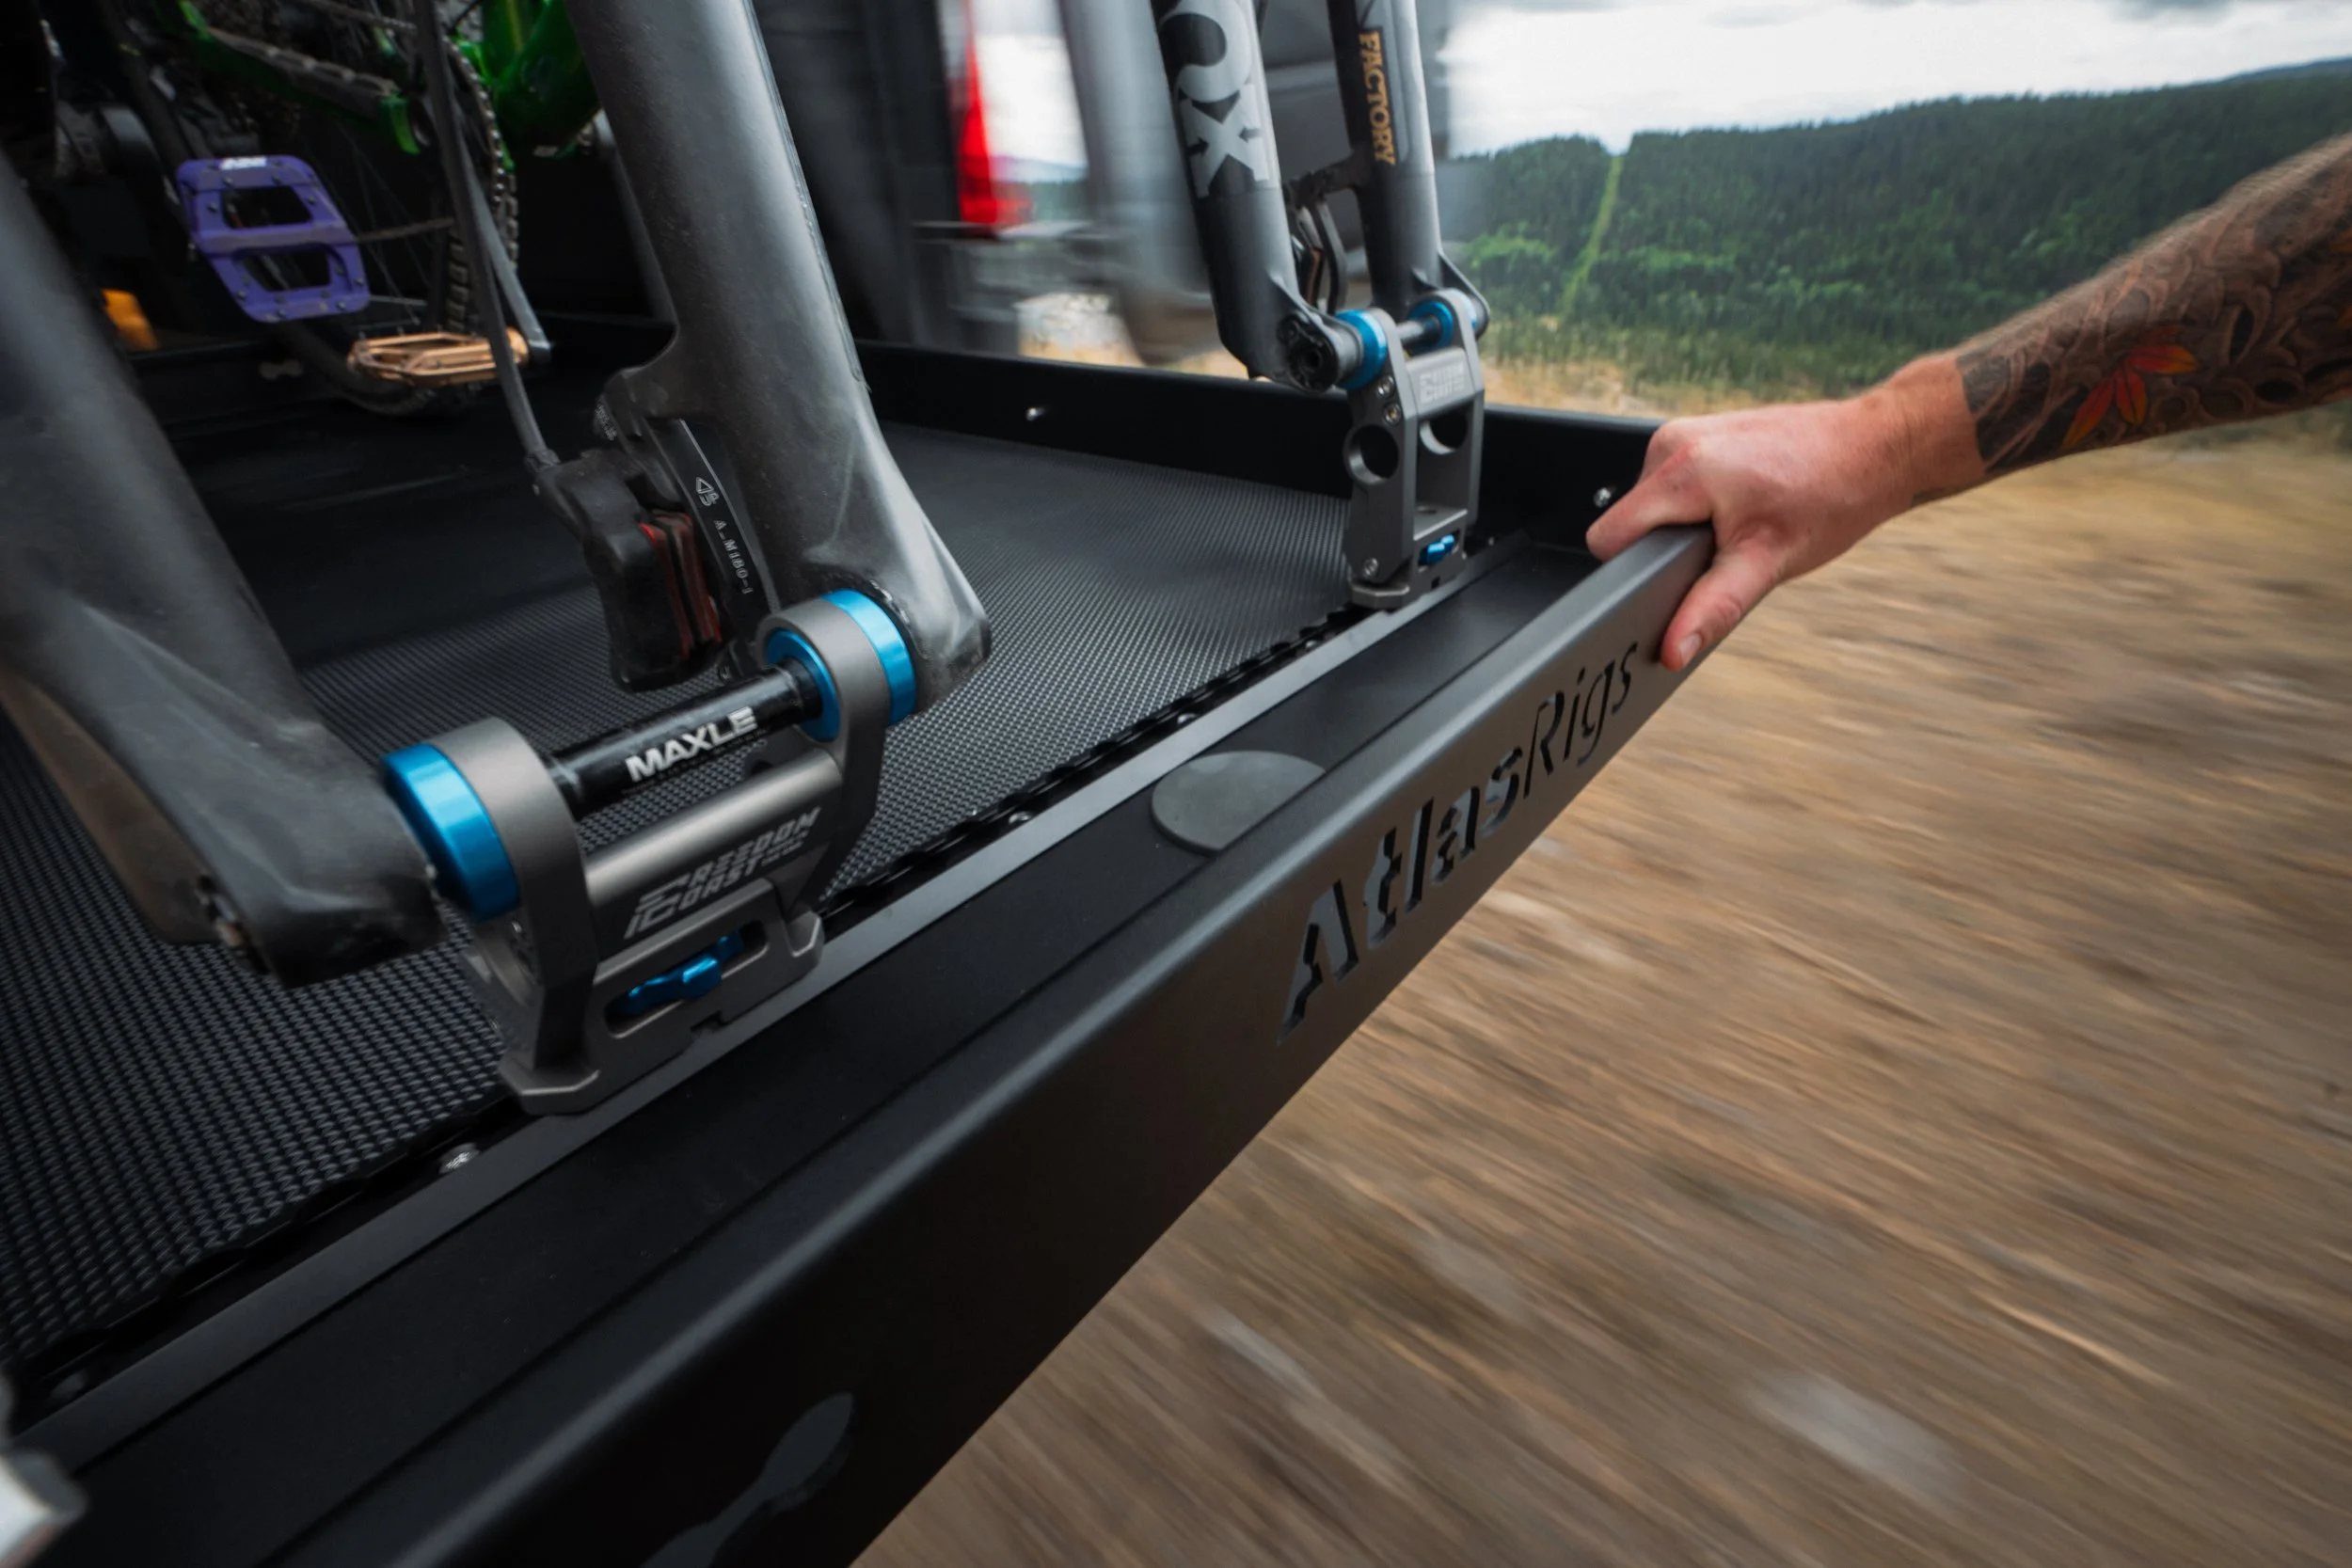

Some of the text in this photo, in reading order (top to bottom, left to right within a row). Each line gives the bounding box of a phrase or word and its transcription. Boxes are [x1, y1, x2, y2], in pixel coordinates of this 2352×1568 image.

[1359, 30, 1396, 166] FACTORY
[625, 706, 757, 783] MAXLE
[1277, 641, 1638, 1046] AtlasRigs
